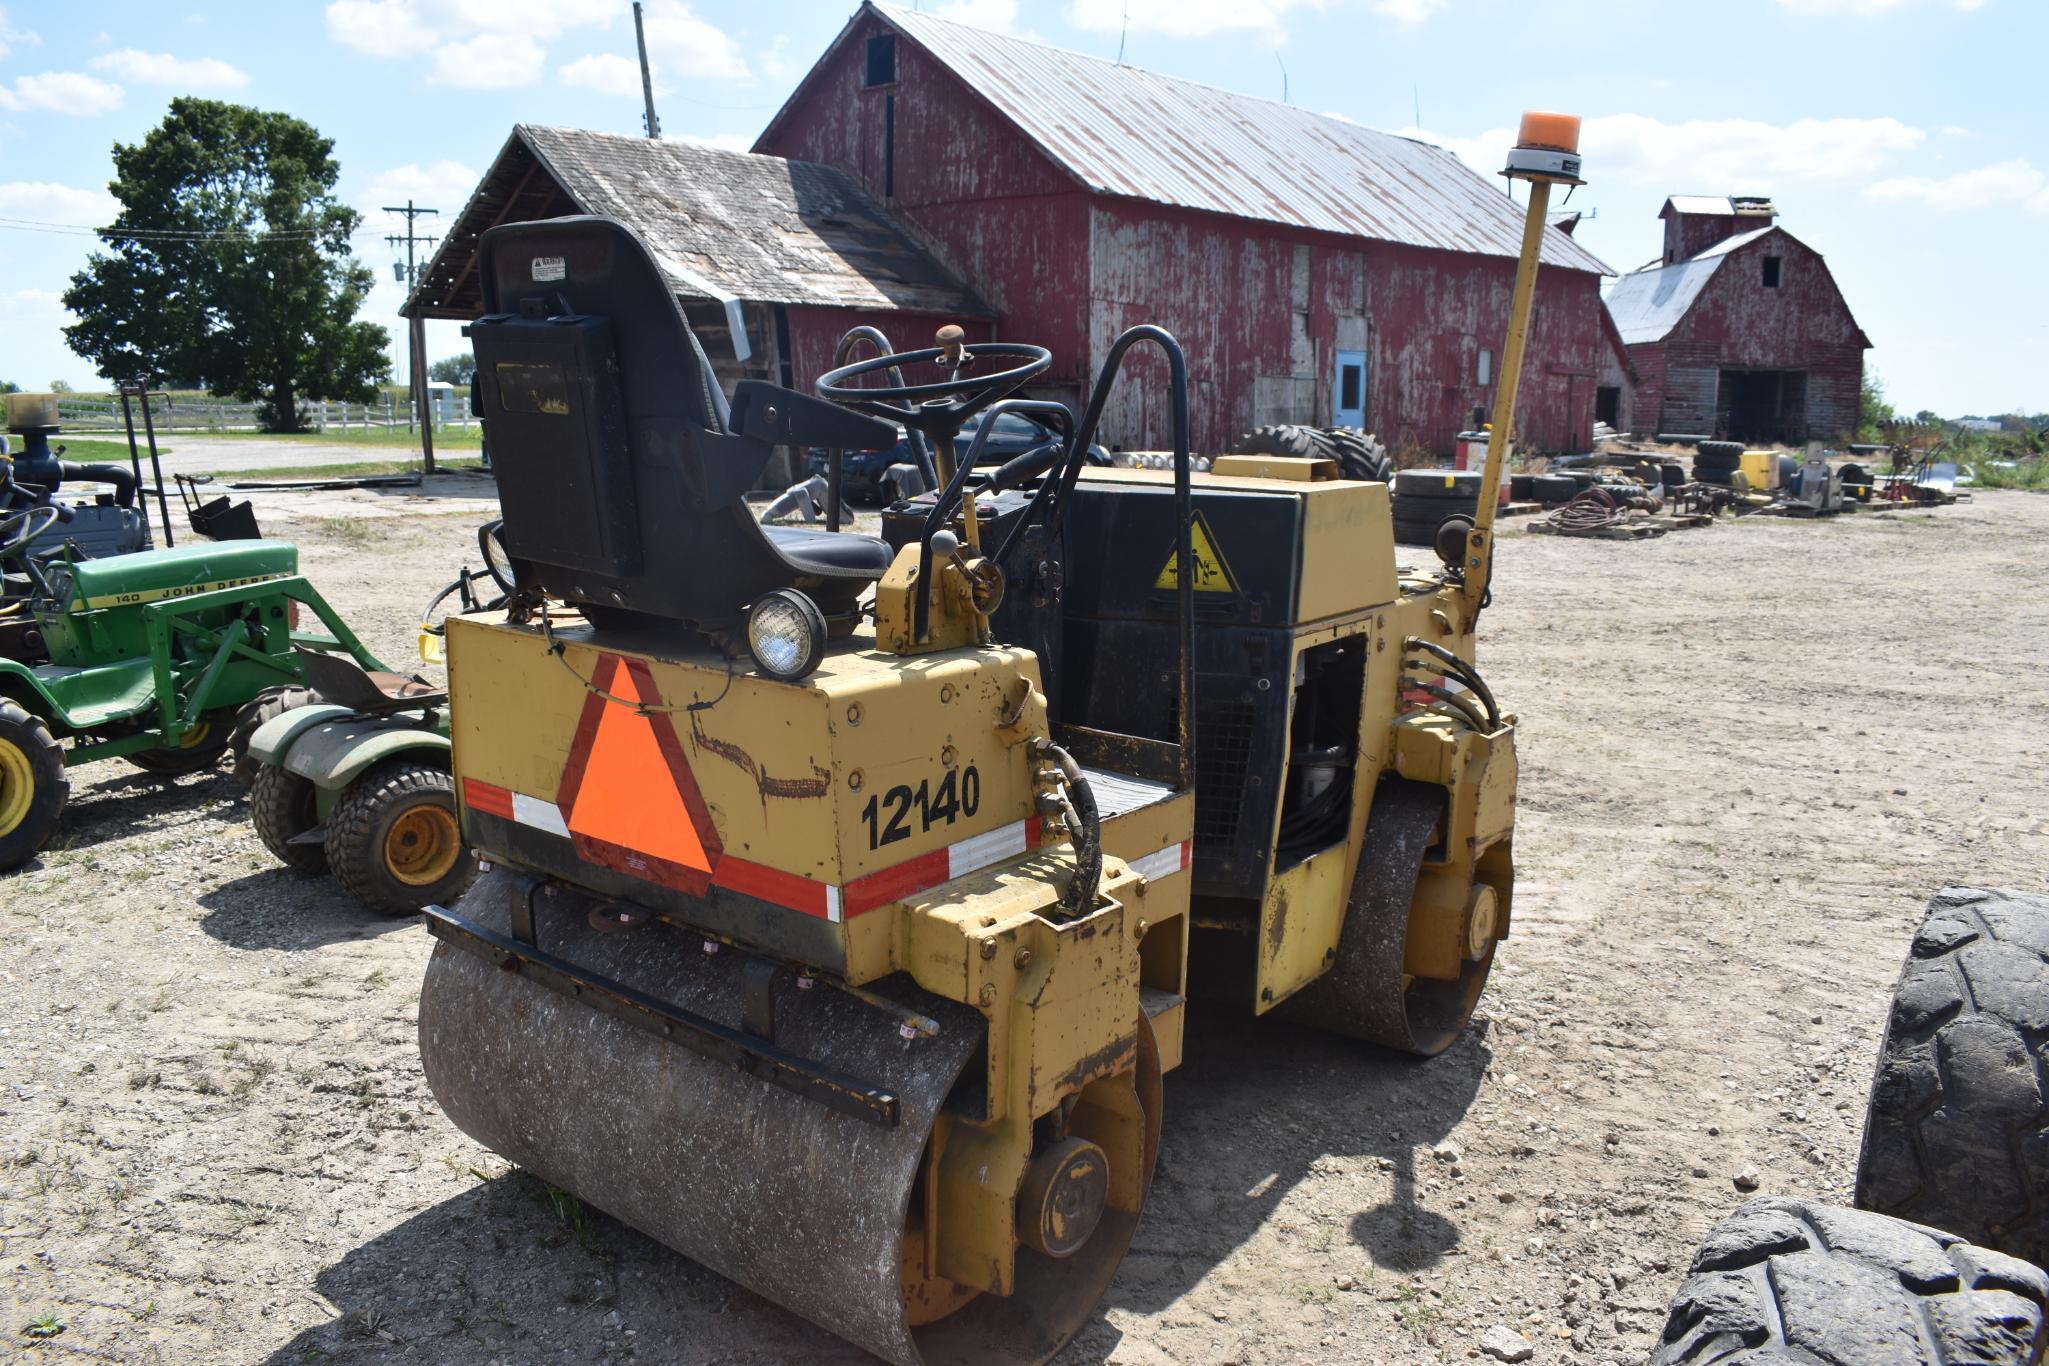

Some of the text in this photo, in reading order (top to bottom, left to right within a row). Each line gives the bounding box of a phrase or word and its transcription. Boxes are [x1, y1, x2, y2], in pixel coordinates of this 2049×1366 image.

[116, 593, 140, 604] 140
[162, 585, 205, 597] JOHN
[862, 765, 979, 850] 12140
